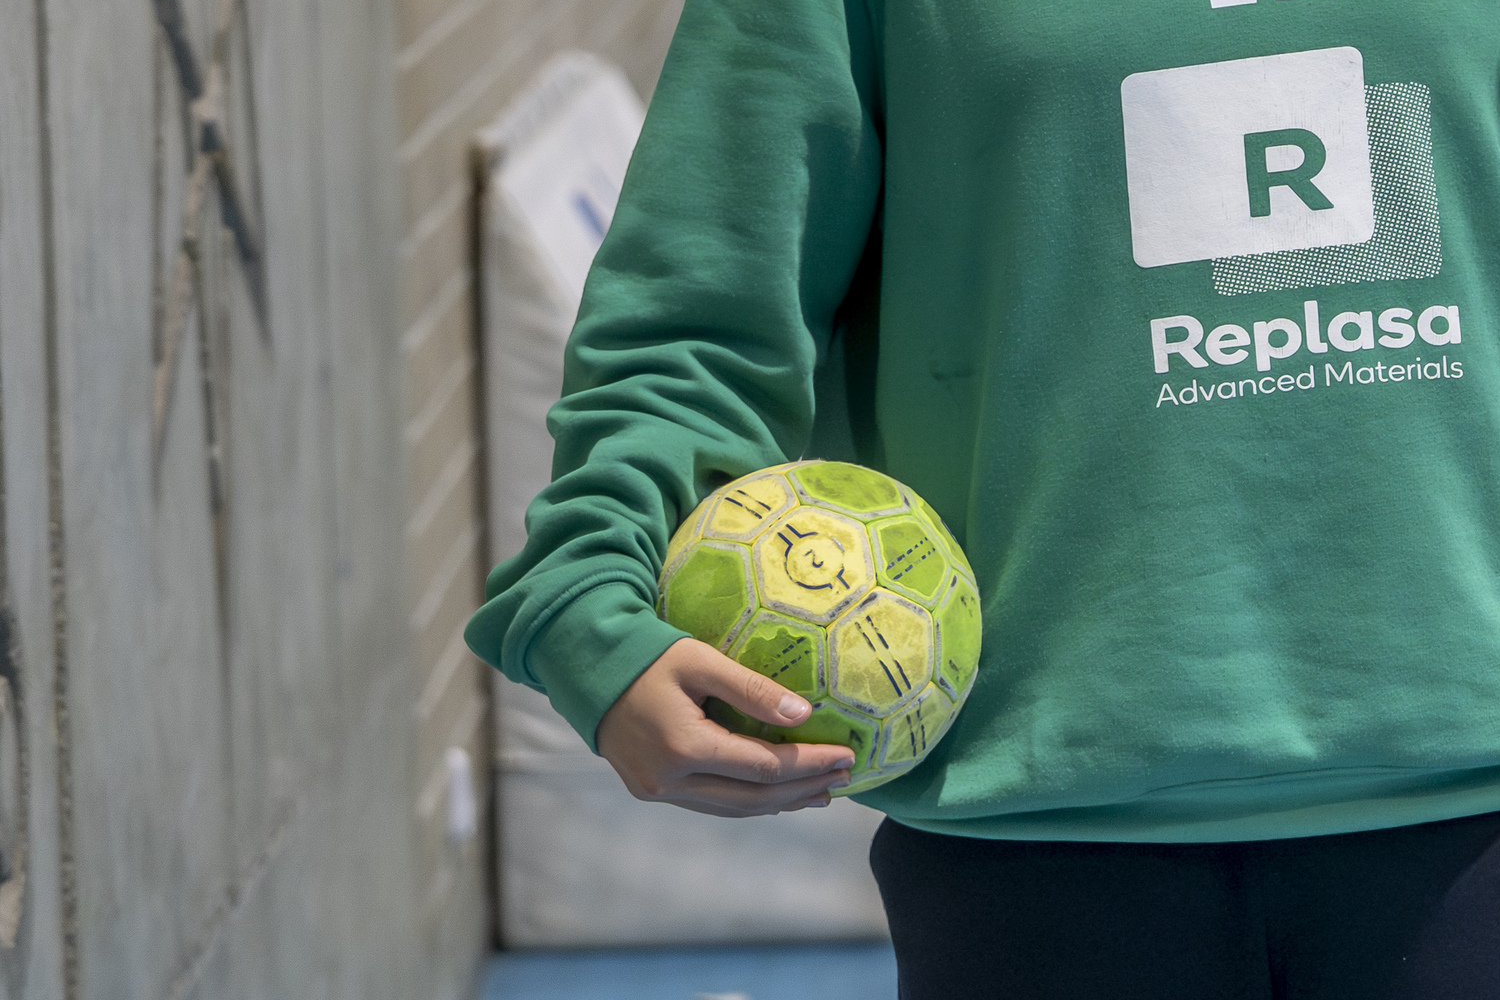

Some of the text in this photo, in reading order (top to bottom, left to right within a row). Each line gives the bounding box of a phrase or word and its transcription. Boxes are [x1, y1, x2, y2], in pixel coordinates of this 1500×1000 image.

[1243, 128, 1334, 218] R
[1150, 300, 1462, 374] Replasa
[1156, 355, 1464, 408] Advanced Materials
